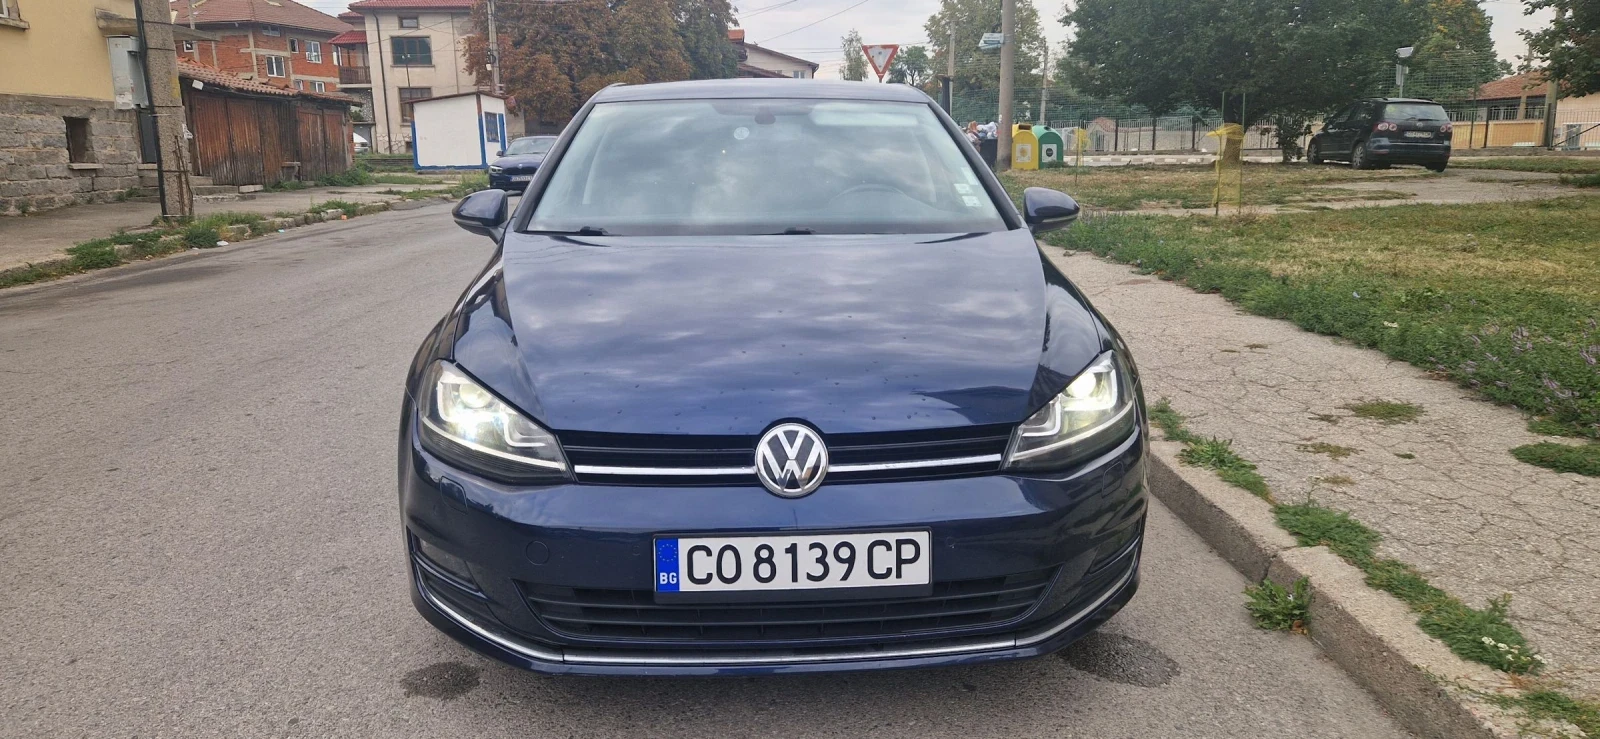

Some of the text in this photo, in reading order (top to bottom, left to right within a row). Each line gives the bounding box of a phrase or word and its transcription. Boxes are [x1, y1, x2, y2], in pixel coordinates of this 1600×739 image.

[760, 428, 823, 492] VW
[659, 572, 677, 585] BG
[686, 538, 921, 585] CO 8139 CP
